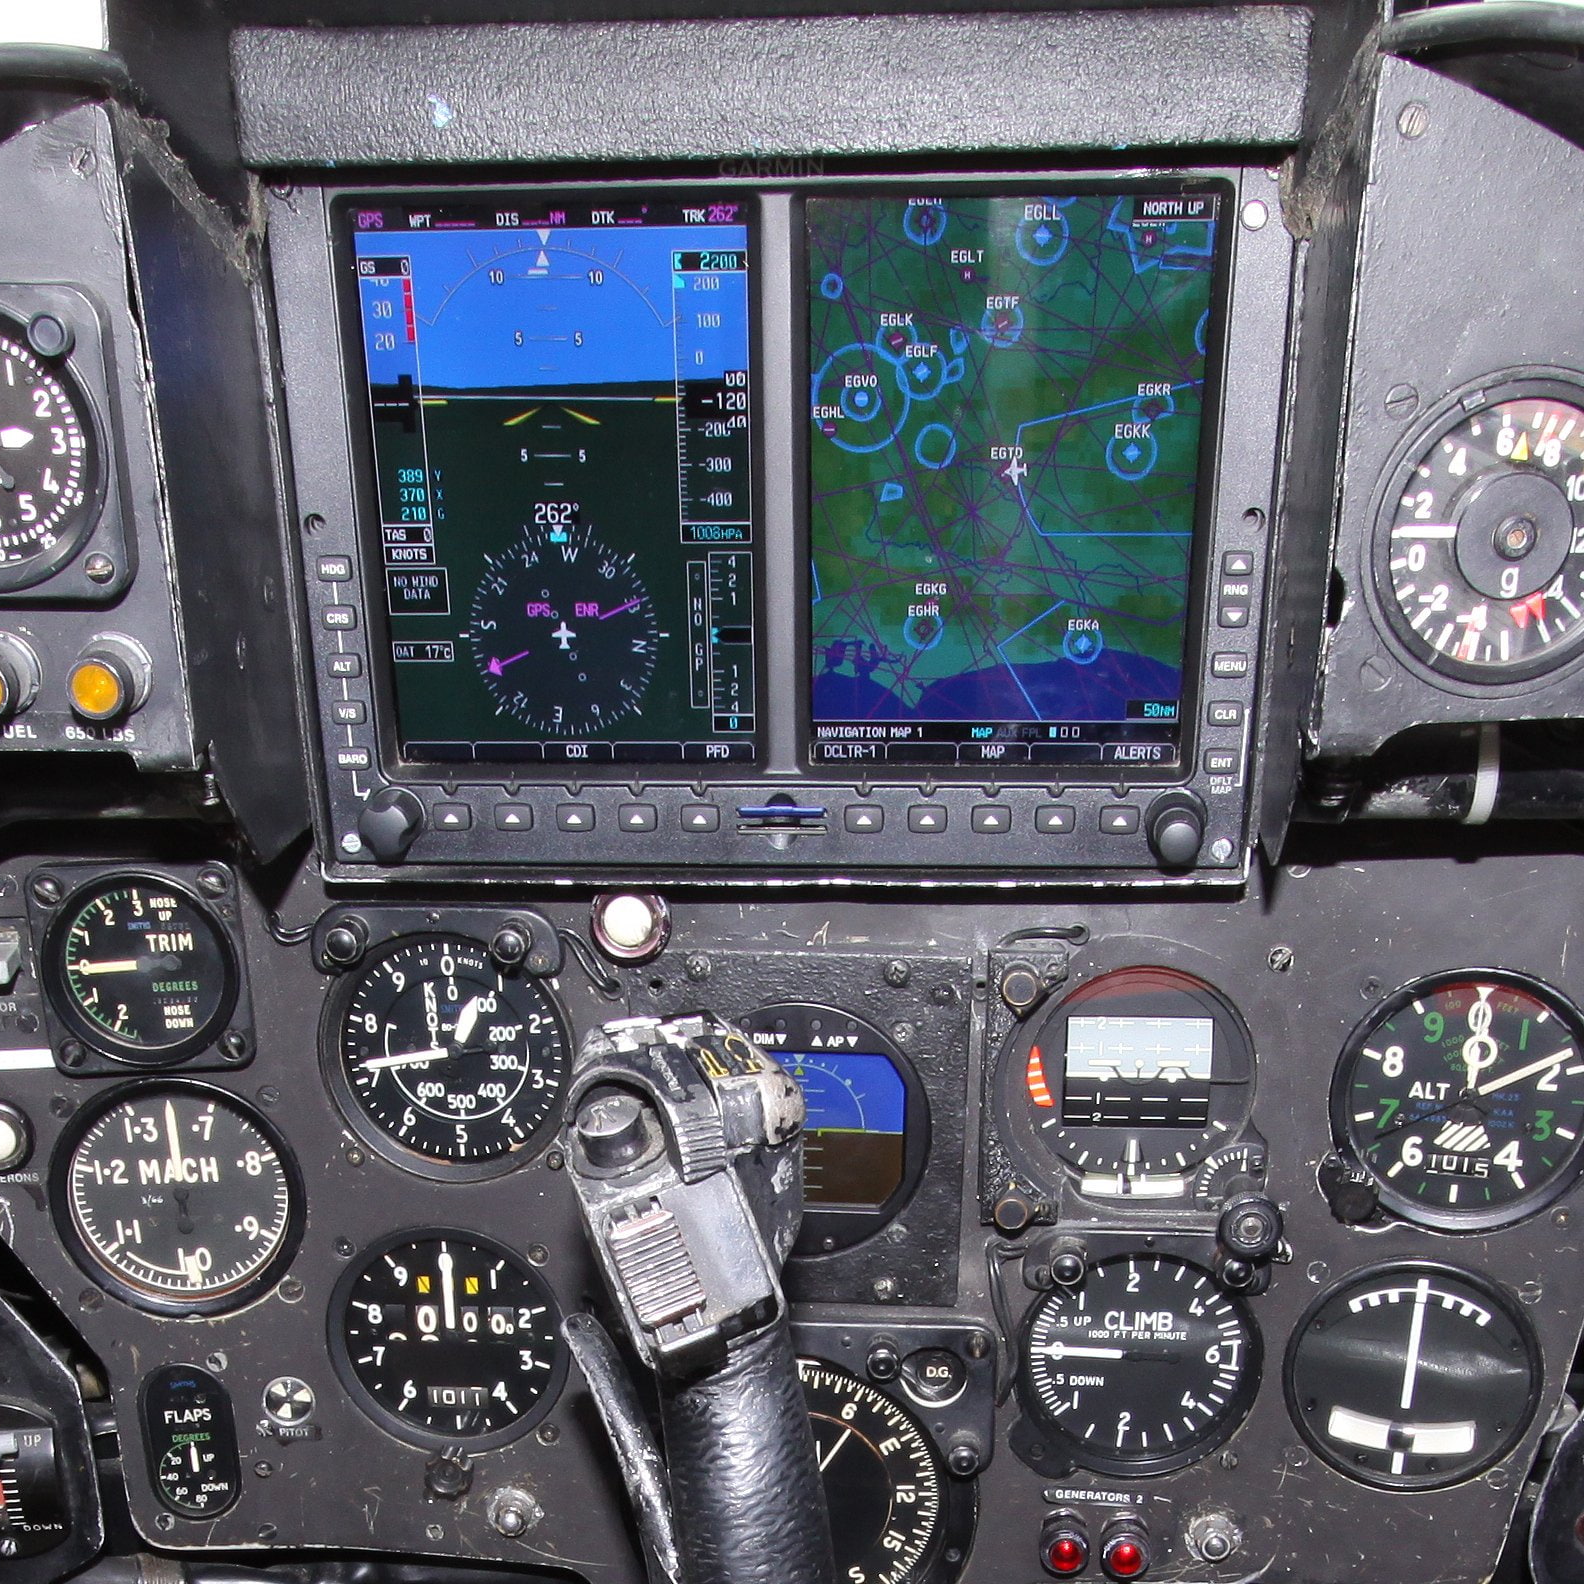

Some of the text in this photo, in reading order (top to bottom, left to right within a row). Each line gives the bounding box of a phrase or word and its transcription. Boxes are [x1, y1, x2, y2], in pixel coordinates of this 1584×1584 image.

[682, 208, 706, 224] TRK
[1023, 204, 1061, 221] EGLL
[1142, 201, 1205, 217] NORTH UP
[357, 212, 520, 229] GPS WPT DIS
[591, 210, 616, 225] DTK
[950, 249, 985, 264] EGLT
[359, 260, 376, 275] GS
[985, 295, 1020, 310] EGTF
[880, 312, 914, 327] EGLK
[904, 344, 938, 358] EGLF
[1137, 383, 1172, 397] EGKR
[812, 405, 845, 420] EGHL
[1114, 424, 1151, 440] EGKK
[384, 528, 407, 543] TAS
[391, 547, 427, 562] KNOTS
[320, 562, 346, 576] HDG
[392, 574, 440, 589] NO WIND
[403, 587, 432, 601] DATA
[1223, 583, 1249, 597] RNG
[526, 603, 551, 618] GPS
[575, 603, 600, 618] ENR
[907, 604, 940, 618] EGHR
[325, 612, 350, 625] CRS
[1067, 618, 1100, 633] EGKA
[333, 660, 352, 673] ALT
[1213, 659, 1247, 673] MENU
[338, 707, 357, 719] V/S
[1214, 708, 1238, 722] CLR
[817, 726, 924, 740] NAVIGATION MAP 1
[337, 752, 368, 765] BARO
[565, 744, 589, 759] CDI
[705, 744, 730, 759] PFD
[823, 743, 877, 759] DCLTR-1
[980, 744, 1006, 760] MAP
[1113, 744, 1162, 761] ALERTS
[1210, 756, 1234, 770] ENT
[149, 896, 178, 909] NOSE
[158, 909, 173, 922] UP
[144, 933, 194, 953] TRIM
[151, 981, 199, 993] DEGREES
[163, 1005, 192, 1017] NOSE
[165, 1017, 195, 1029] DOWN
[753, 1032, 775, 1047] DIM
[826, 1035, 845, 1049] AP
[489, 1055, 518, 1070] 300
[1408, 1081, 1451, 1102] ALT
[447, 1094, 476, 1110] 500
[1103, 1310, 1174, 1332] CLIMB
[1112, 1330, 1188, 1341] FT PER MINUTE
[925, 1364, 952, 1380] D.G.
[163, 1408, 213, 1424] FLAPS
[171, 1433, 211, 1443] DEGREES
[200, 1482, 229, 1493] DOWN
[1054, 1489, 1131, 1504] GENERATORS
